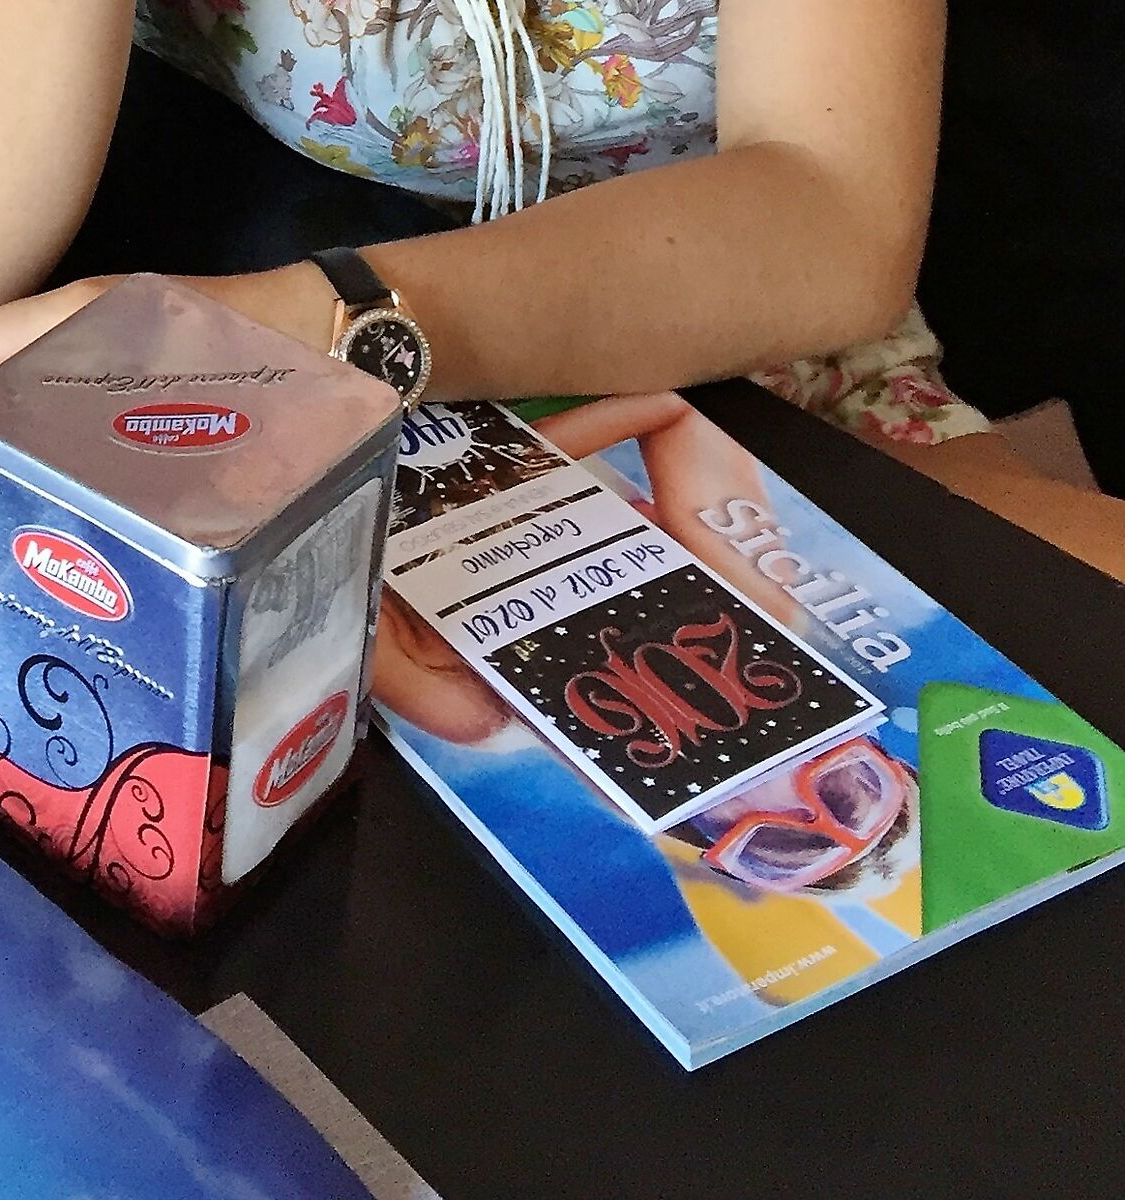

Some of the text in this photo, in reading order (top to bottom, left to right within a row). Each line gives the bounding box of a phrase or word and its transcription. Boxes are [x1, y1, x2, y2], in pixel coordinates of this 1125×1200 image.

[461, 517, 582, 575] Capodanno
[624, 542, 667, 572] dal
[530, 587, 558, 611] al
[697, 497, 913, 674] Sicilia
